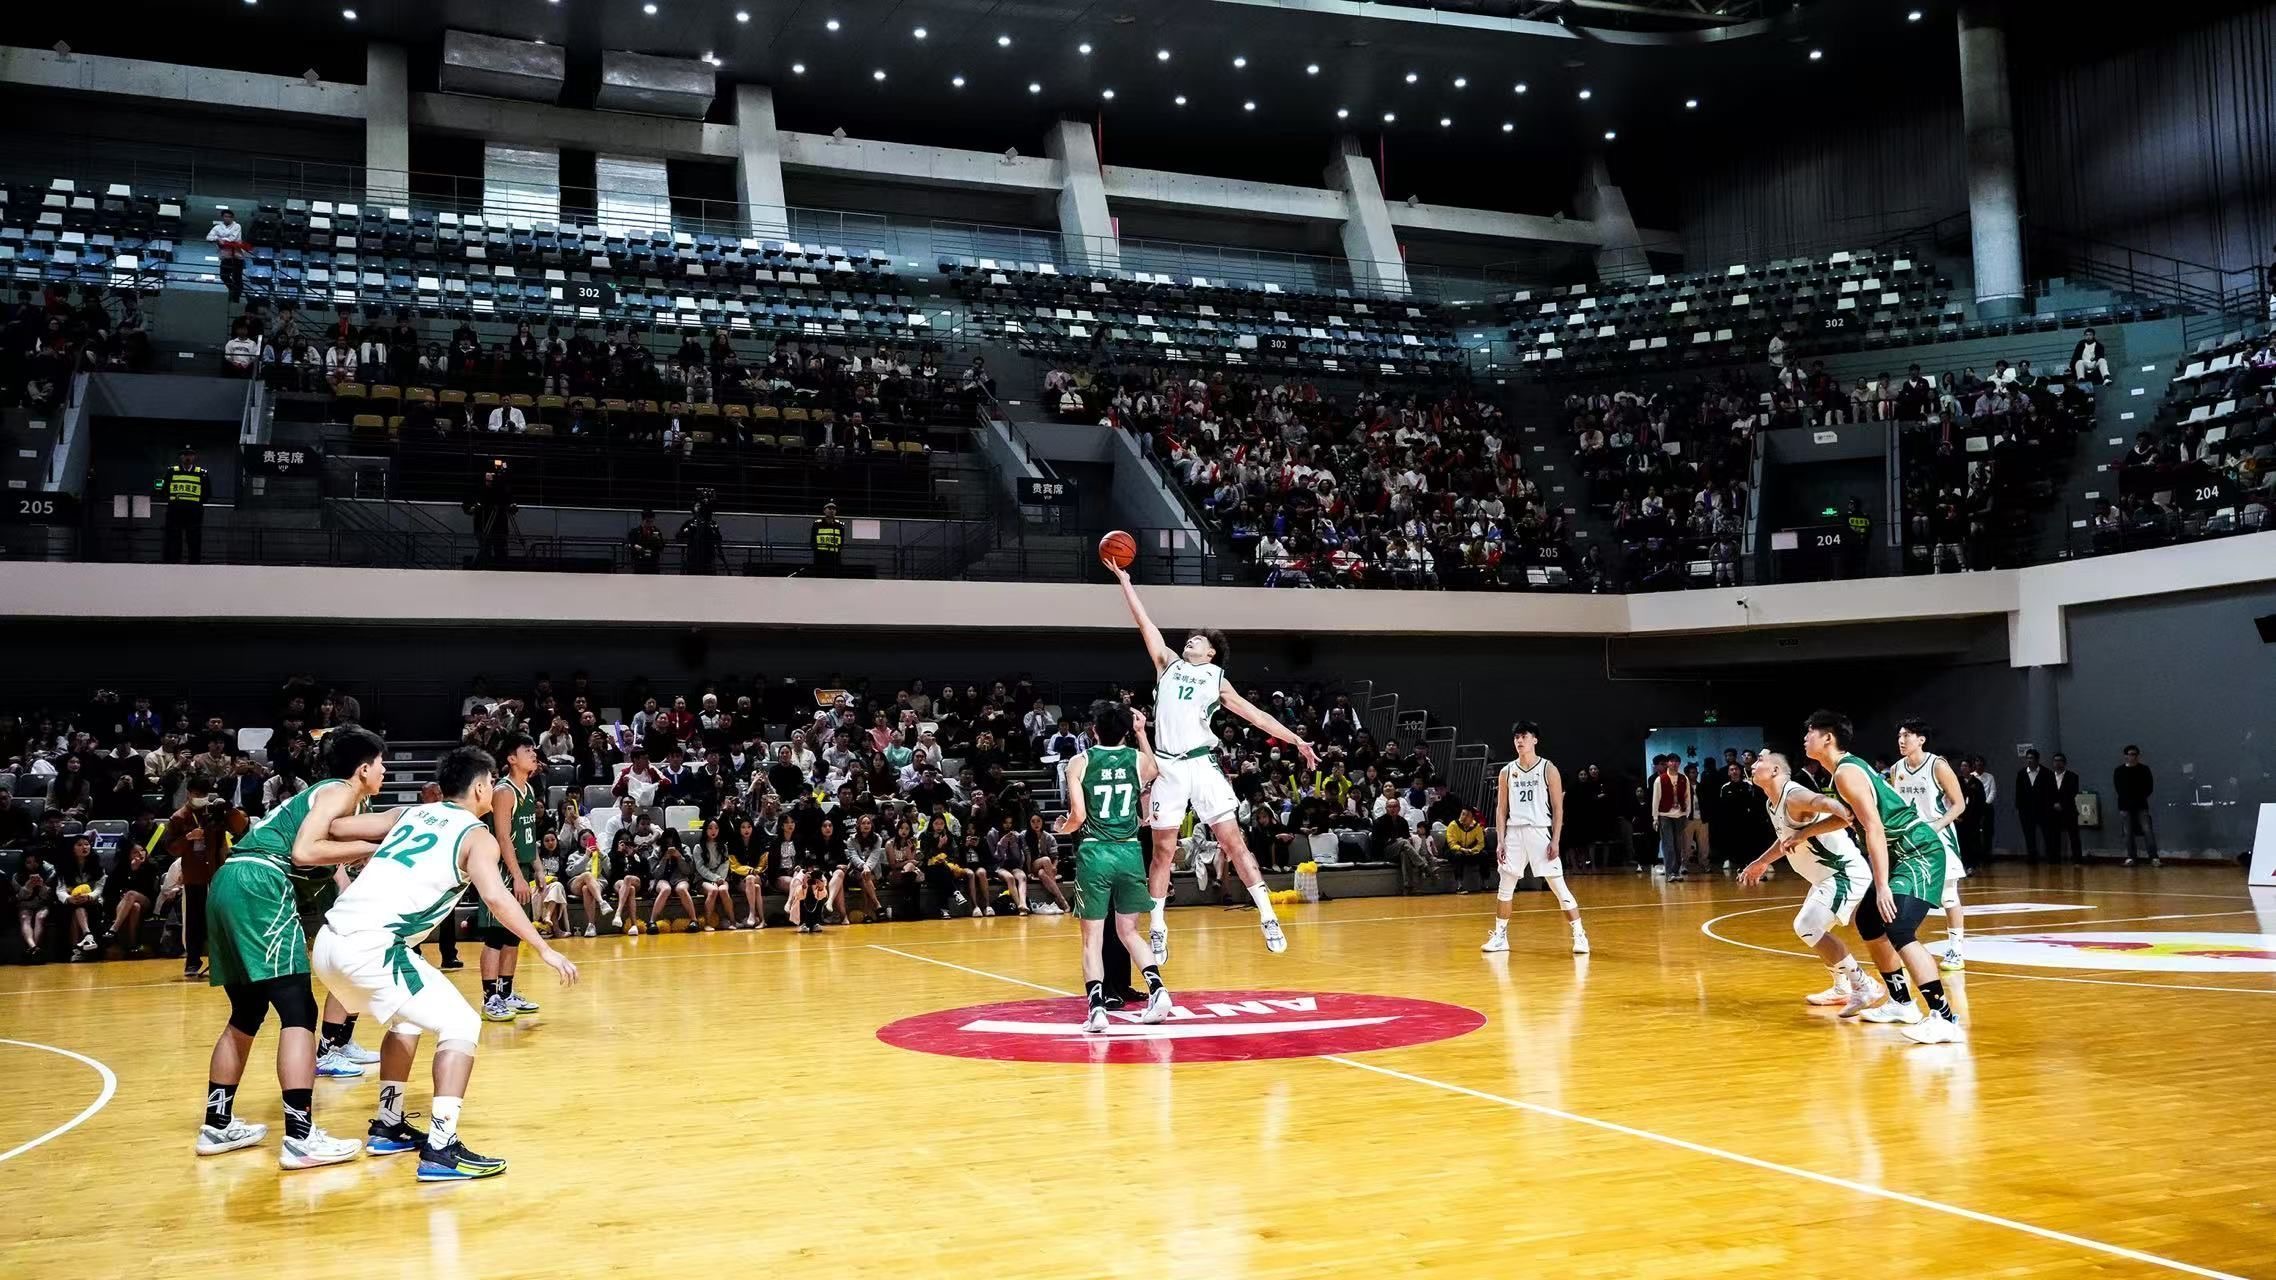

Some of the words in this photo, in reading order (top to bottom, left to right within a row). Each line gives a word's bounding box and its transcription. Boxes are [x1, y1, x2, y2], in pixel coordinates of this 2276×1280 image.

[578, 287, 600, 299] 302
[1824, 317, 1845, 329] 302
[1270, 339, 1288, 350] 302
[263, 449, 305, 465] 贵宾席
[1031, 482, 1064, 496] 贵宾席
[2195, 485, 2221, 502] 204
[19, 499, 55, 515] 205
[1816, 533, 1842, 547] 204
[1538, 546, 1560, 559] 205
[1173, 672, 1207, 686] 深圳大学
[1178, 685, 1195, 701] 12
[1101, 767, 1127, 781] 张杰
[1513, 780, 1540, 789] 深圳大学
[1899, 786, 1927, 795] 深圳大学
[1093, 782, 1134, 820] 77
[1519, 789, 1534, 803] 20
[1152, 801, 1161, 812] 12
[373, 824, 439, 869] 22
[1106, 997, 1318, 1024] ANTA
